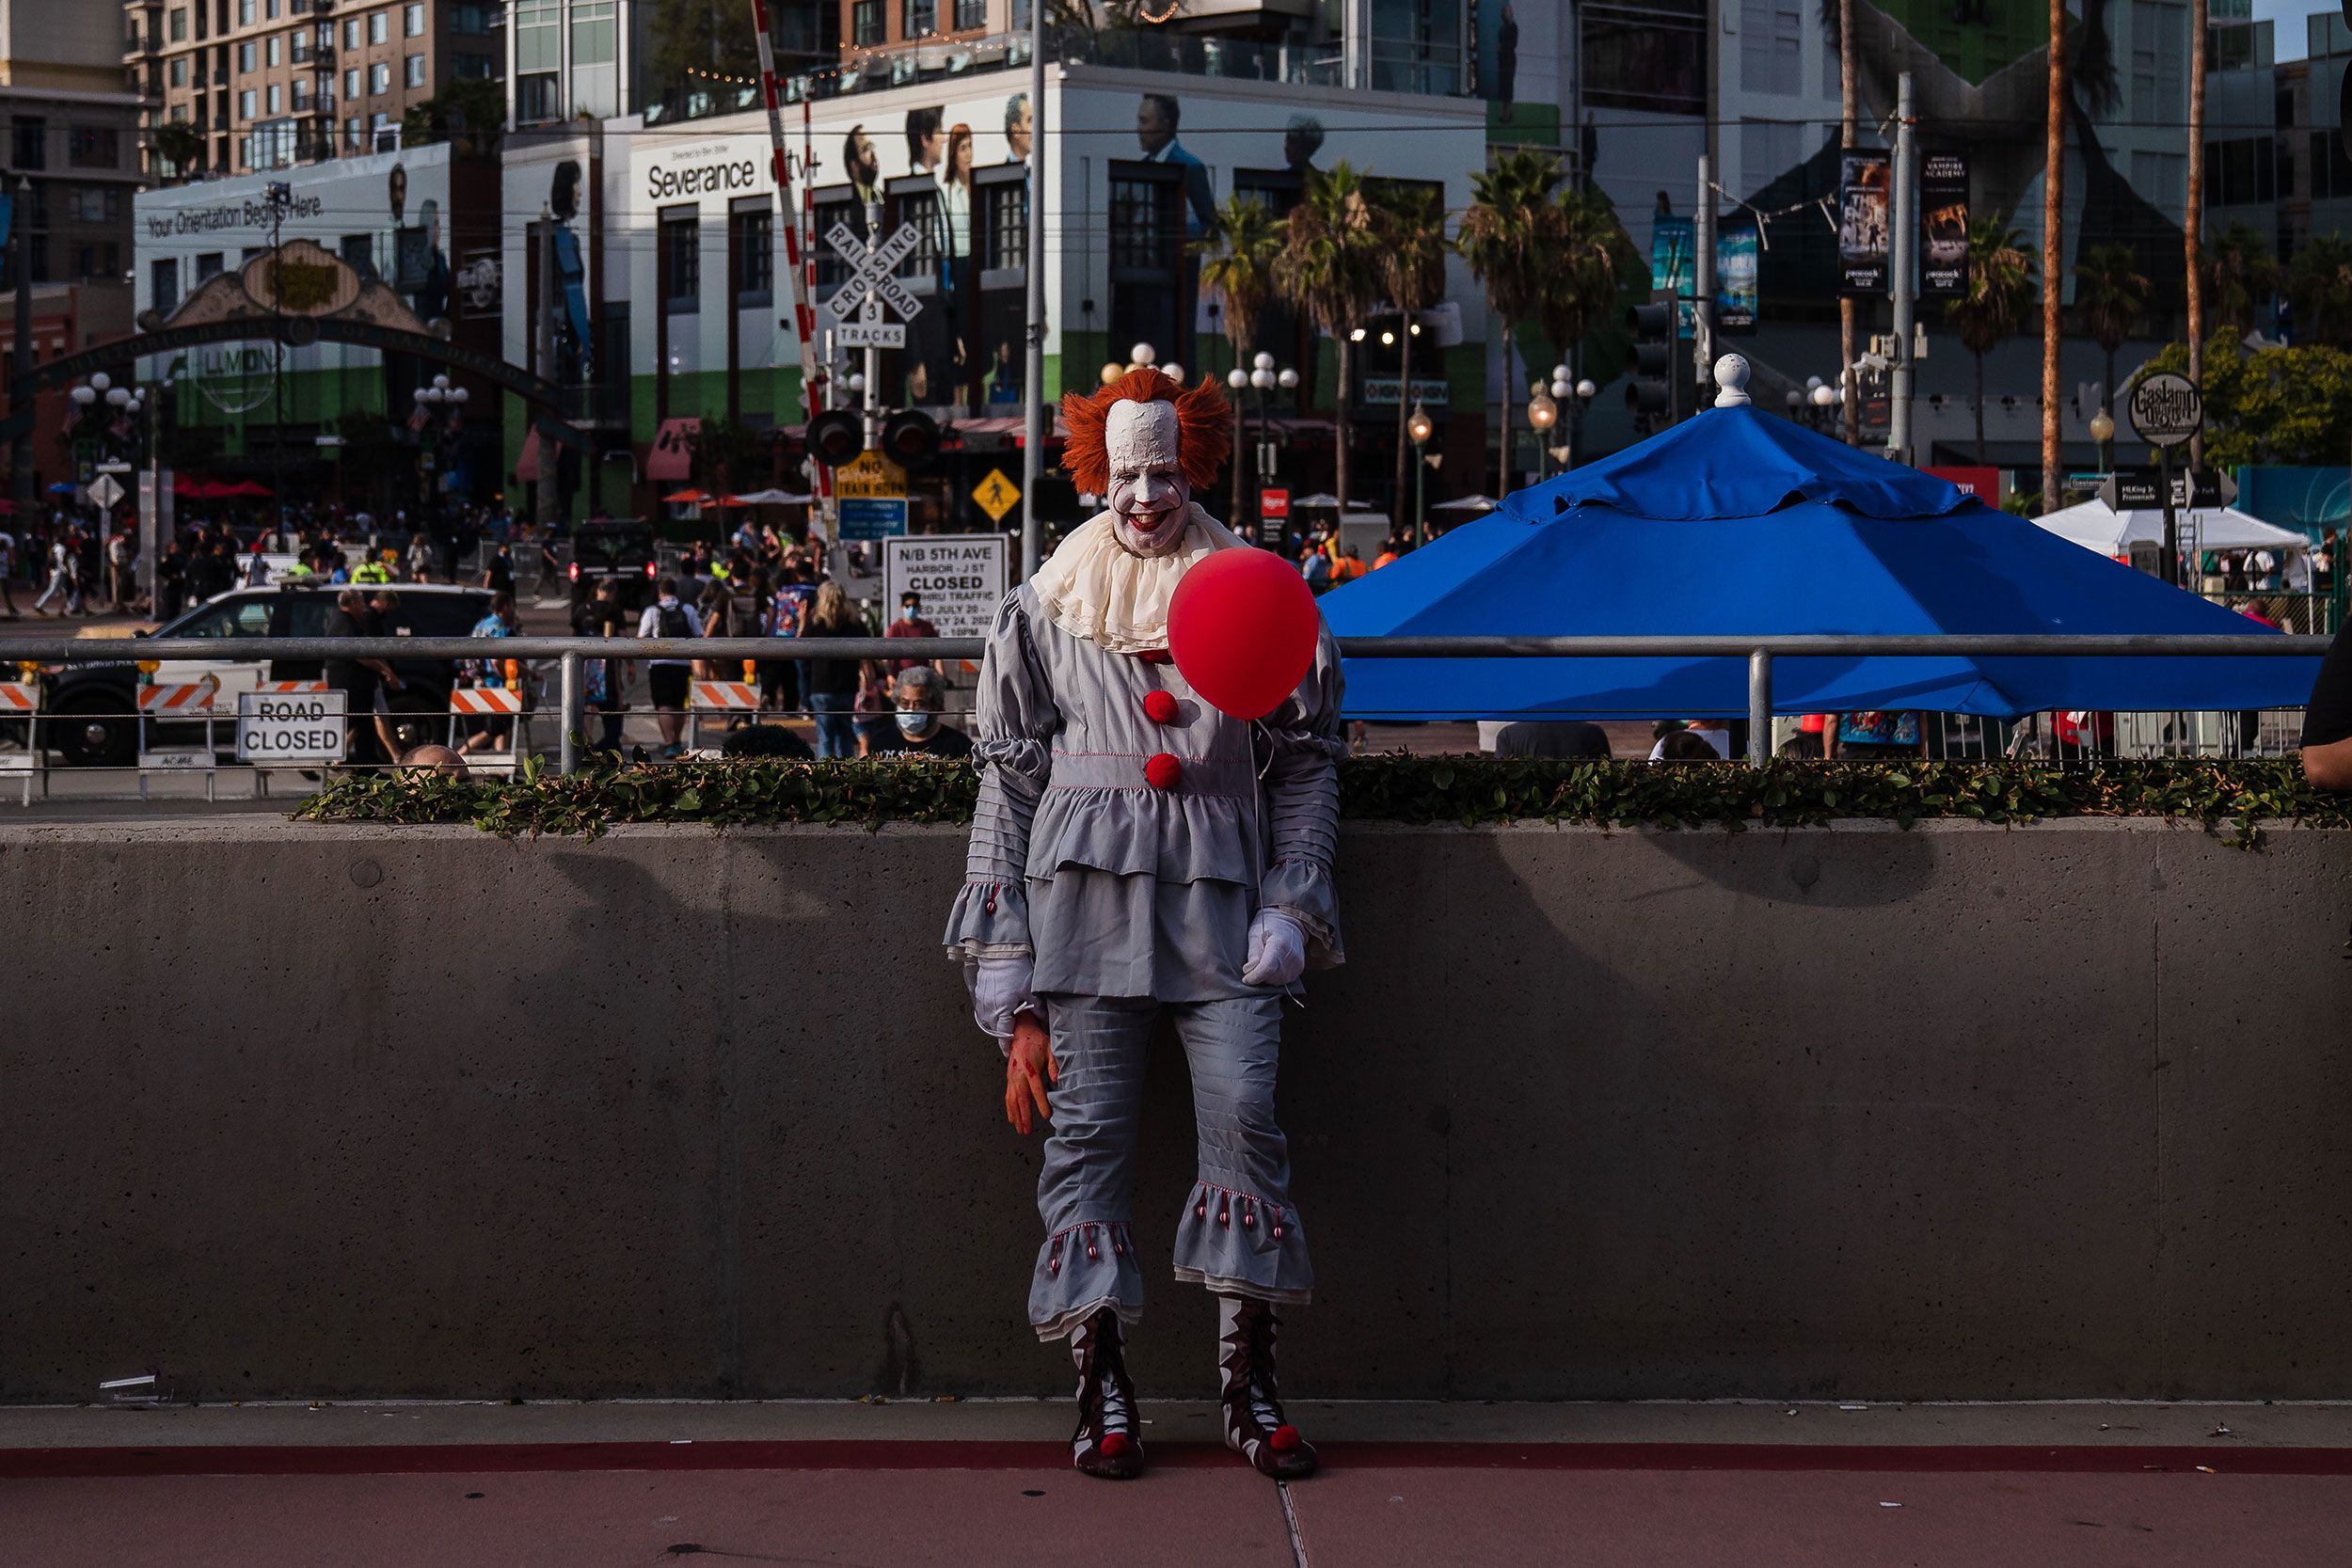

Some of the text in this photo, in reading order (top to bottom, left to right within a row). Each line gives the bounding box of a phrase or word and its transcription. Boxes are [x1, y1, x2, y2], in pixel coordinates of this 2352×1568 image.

[1927, 162, 1964, 171] VAMPIRE
[649, 160, 755, 198] Severance
[149, 216, 173, 237] Your
[177, 205, 242, 234] Orientation
[245, 200, 287, 229] Begins
[831, 228, 917, 316] RAIL ROAD
[832, 228, 916, 315] CROSSING
[866, 304, 877, 321] 3
[841, 329, 902, 342] TRACKS
[2136, 379, 2198, 414] Gaslamp
[860, 460, 882, 473] NO
[839, 482, 870, 496] TRAIN
[900, 546, 993, 562] N/B 5TH AVE
[907, 563, 954, 574] HARBOR
[972, 563, 986, 574] ST
[910, 576, 984, 591] CLOSED
[949, 591, 994, 601] TRAFFIC
[937, 604, 963, 614] JULY
[261, 703, 325, 722] ROAD
[246, 730, 338, 751] CLOSED
